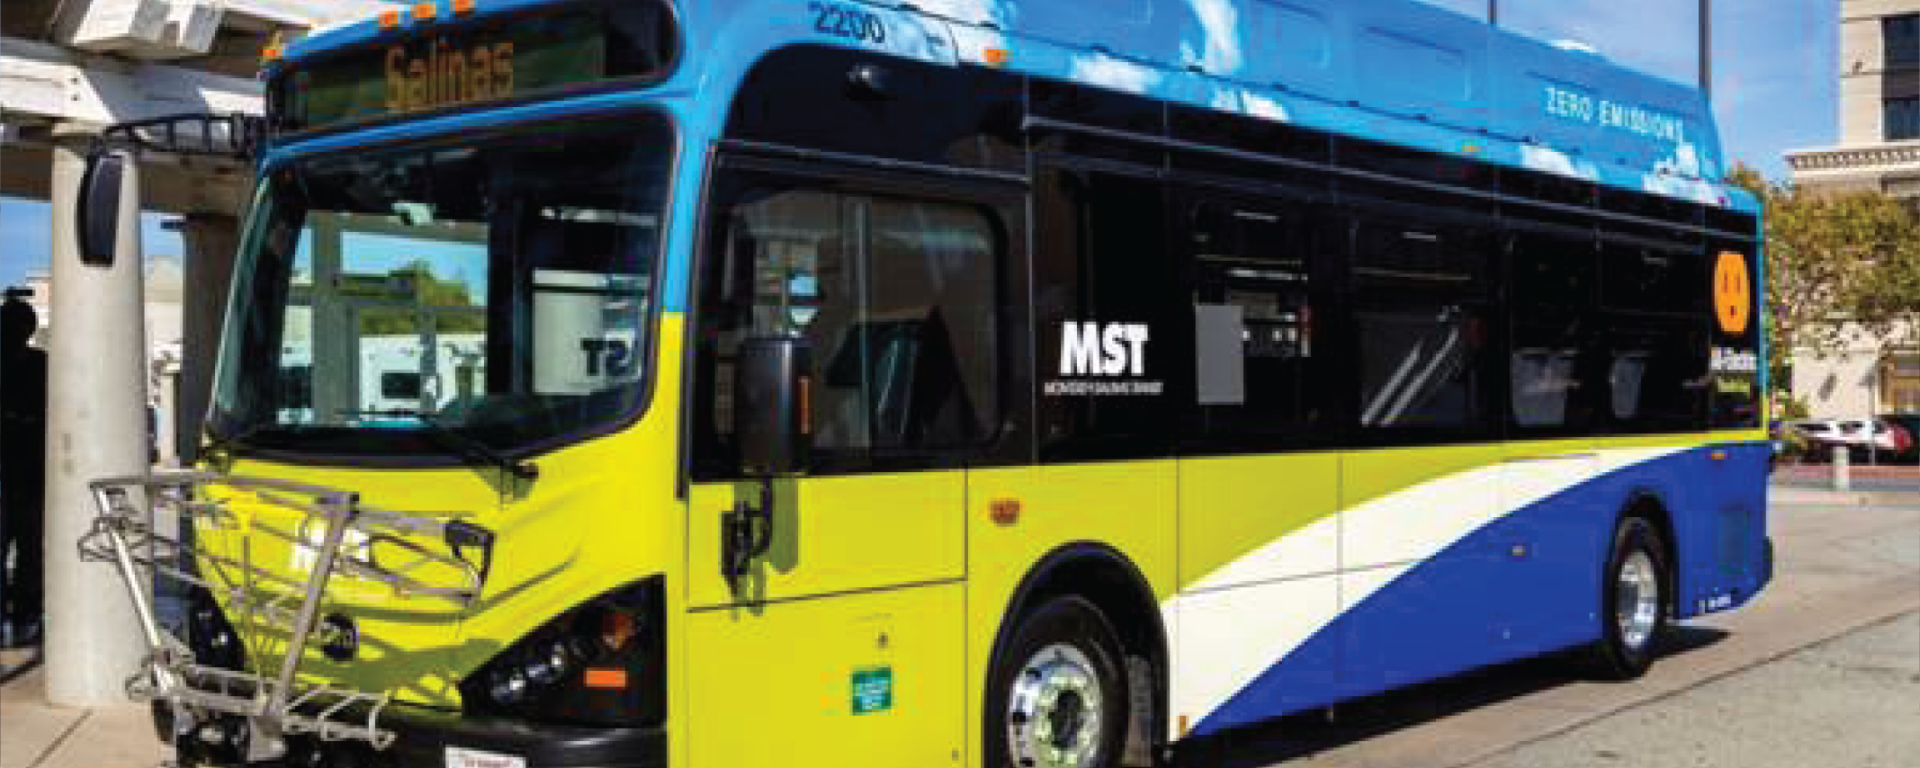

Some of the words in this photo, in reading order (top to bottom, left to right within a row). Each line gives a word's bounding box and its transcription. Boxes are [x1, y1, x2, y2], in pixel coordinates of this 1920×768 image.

[809, 4, 885, 43] 2200
[385, 40, 513, 111] Salinas
[1545, 87, 1592, 124] ZERO
[1599, 100, 1684, 145] EMISSIONS
[1060, 321, 1149, 376] MST
